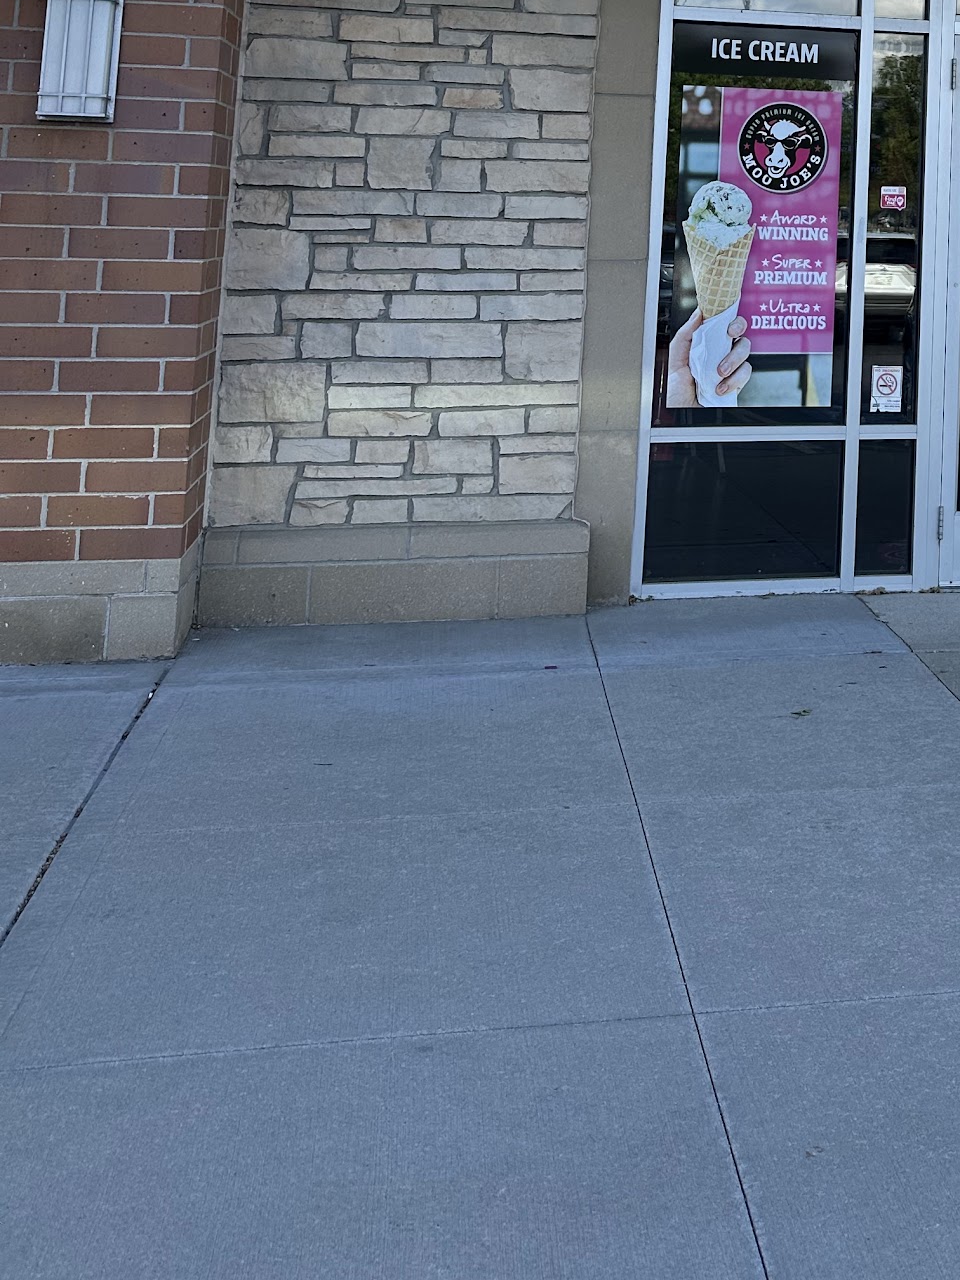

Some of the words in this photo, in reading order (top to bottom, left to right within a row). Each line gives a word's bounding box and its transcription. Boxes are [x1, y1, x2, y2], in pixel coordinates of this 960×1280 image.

[711, 38, 742, 60] ICE
[748, 40, 819, 64] CREAM
[761, 108, 792, 120] PREMIUM
[742, 153, 772, 186] MOO
[780, 155, 821, 188] JOE'S
[757, 226, 829, 241] WINNING
[754, 270, 827, 285] PREMIUM
[751, 315, 826, 330] DELICIOUS
